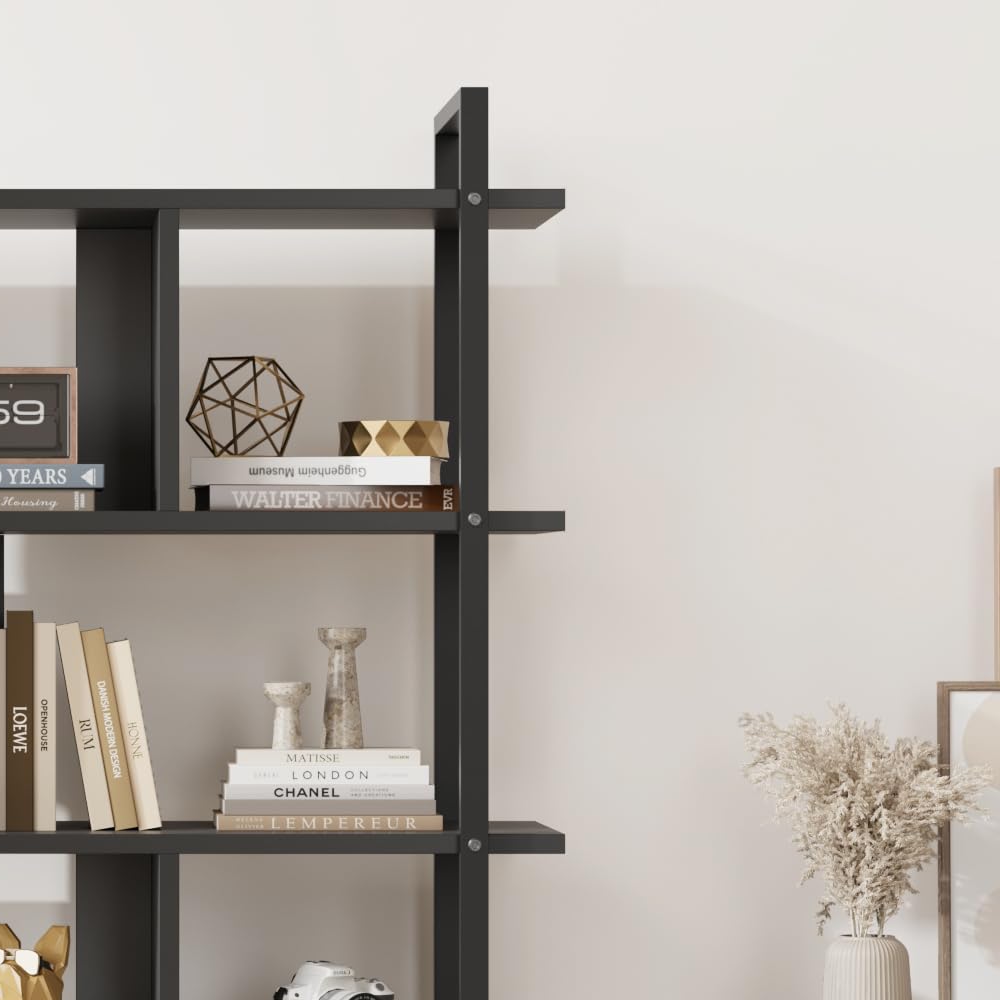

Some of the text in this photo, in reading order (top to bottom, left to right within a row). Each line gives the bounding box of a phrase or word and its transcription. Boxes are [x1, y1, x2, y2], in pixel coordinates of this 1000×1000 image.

[6, 468, 68, 485] YEARS
[248, 466, 367, 478] Guggenheim Museum
[0, 496, 59, 510] Housing
[231, 490, 423, 509] WALTER FINANCE
[443, 488, 453, 510] EVR
[12, 706, 28, 754] LOEWE
[40, 699, 48, 752] OPENHOUSE
[97, 680, 122, 779] DANISH MODERN DESIGN
[286, 753, 340, 763] MATISSE
[292, 770, 369, 780] LONDON
[273, 787, 340, 798] CHANEL
[271, 816, 418, 830] LEMPEREUR
